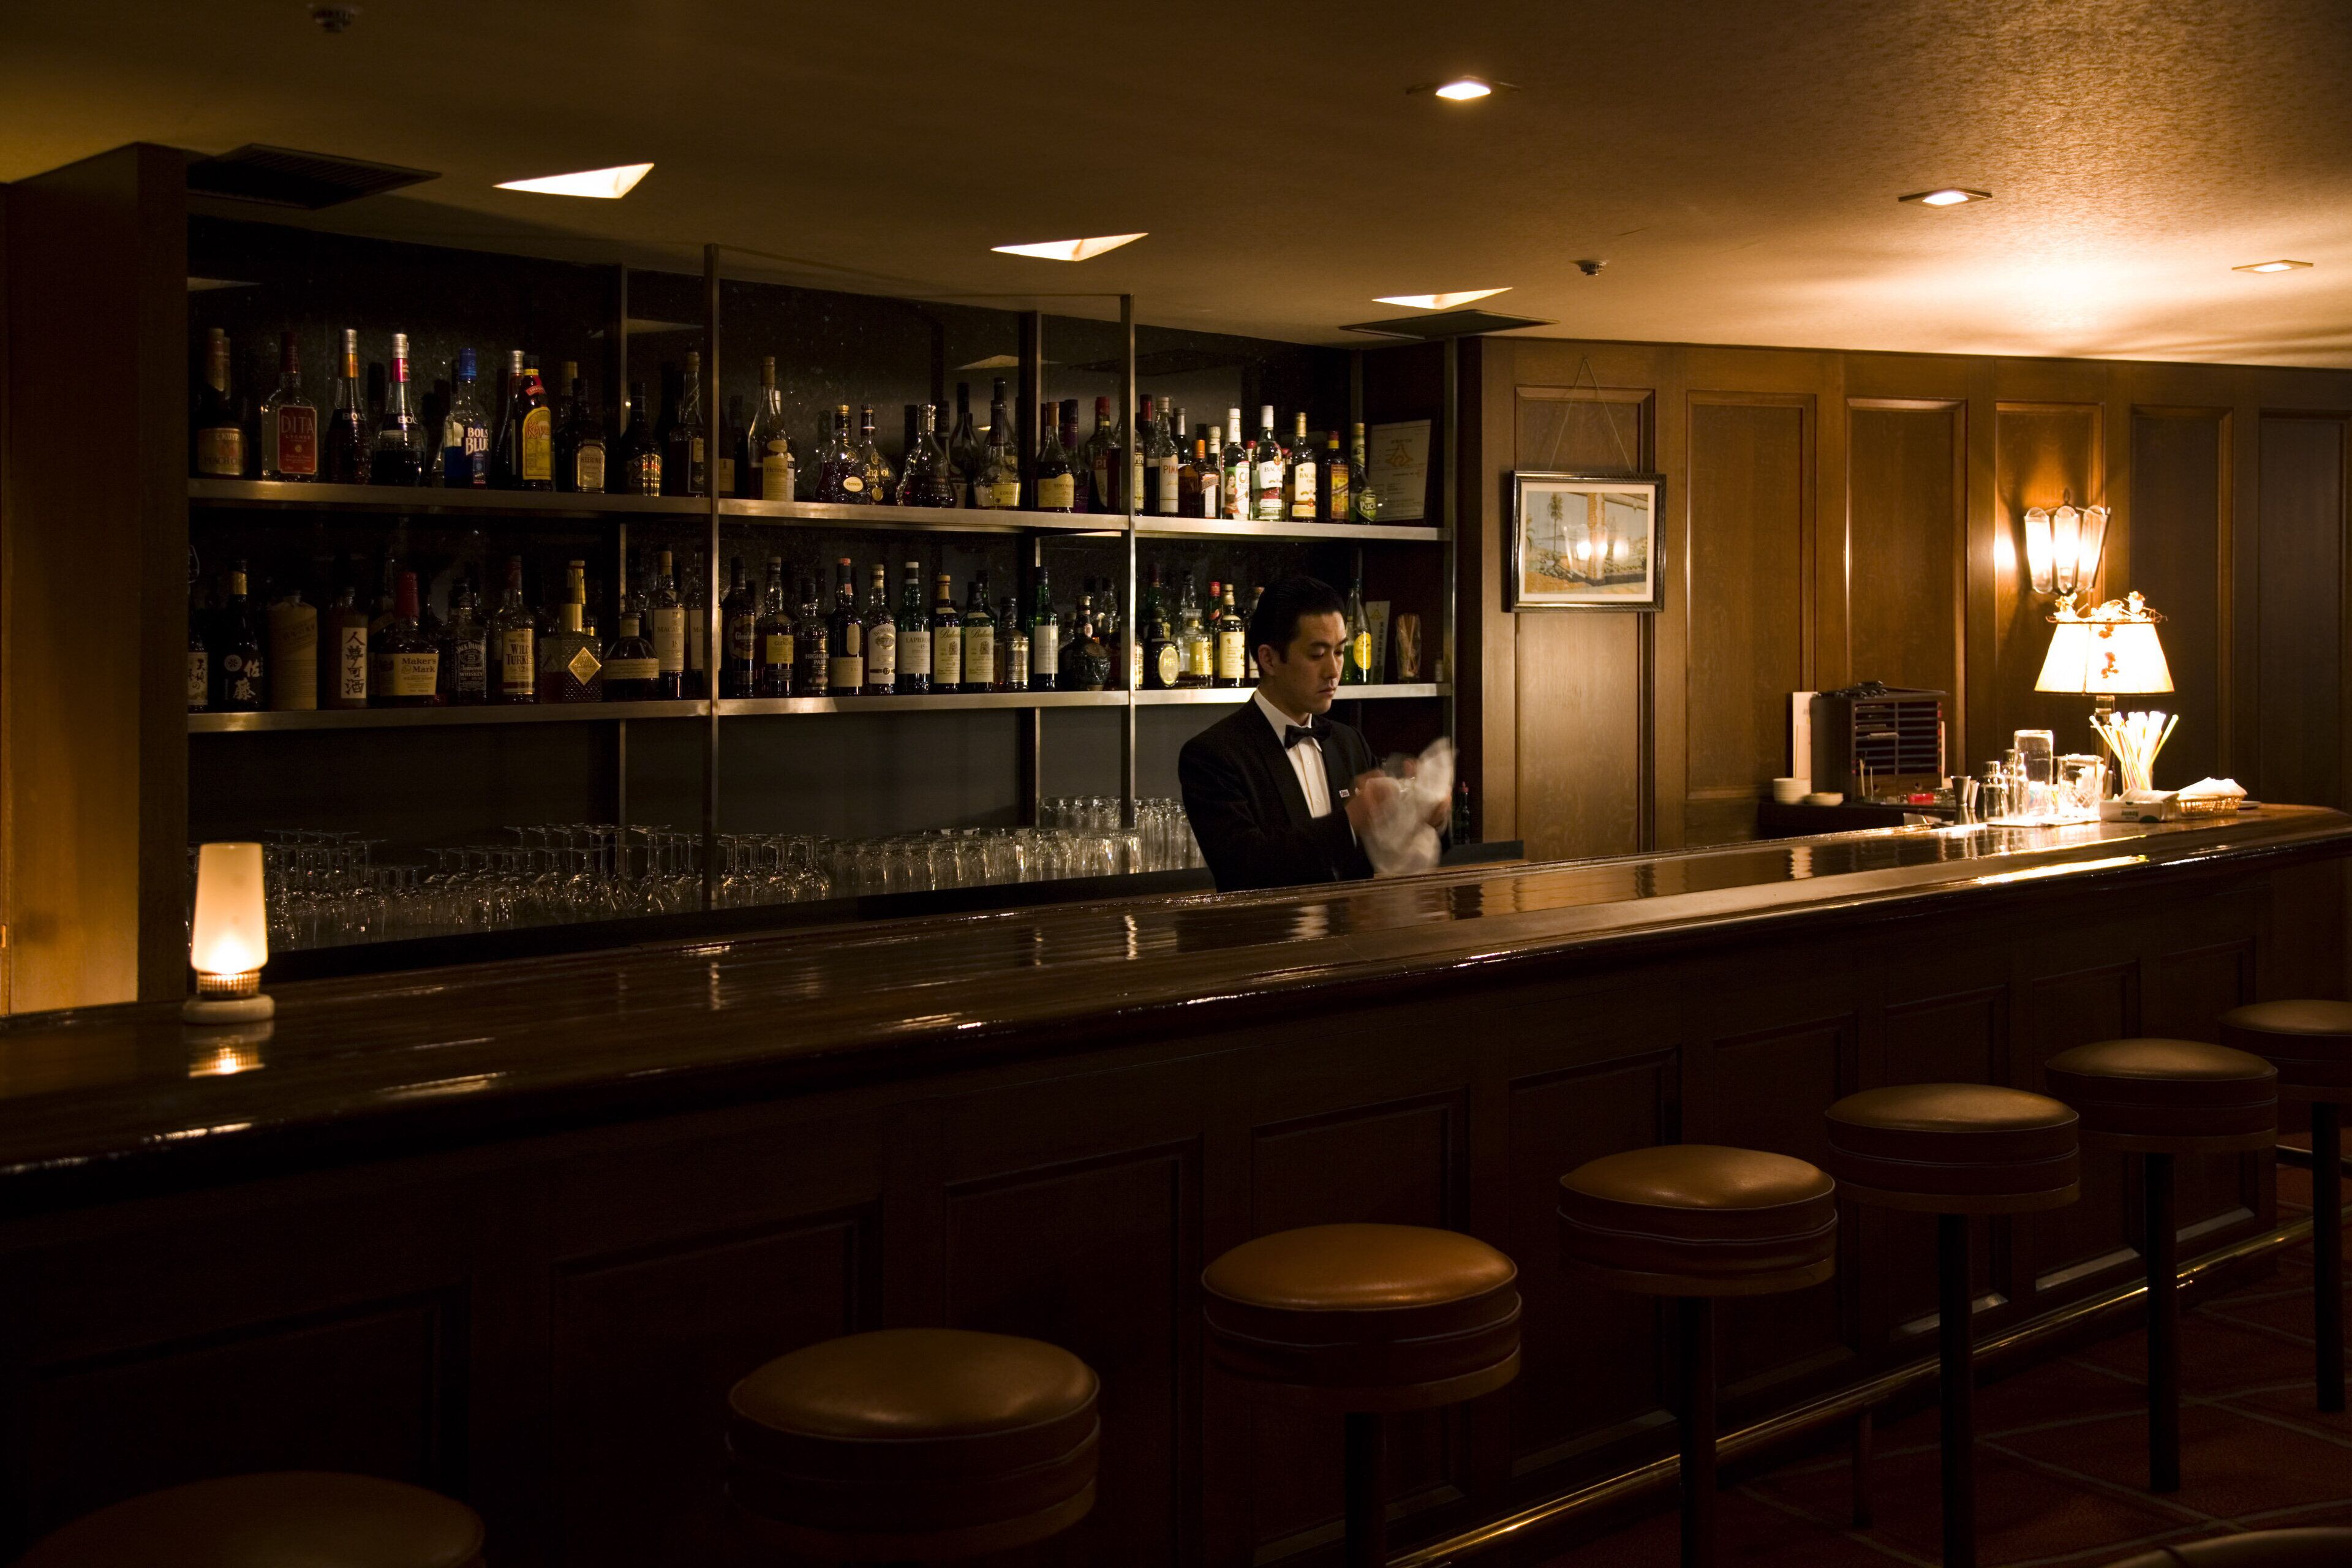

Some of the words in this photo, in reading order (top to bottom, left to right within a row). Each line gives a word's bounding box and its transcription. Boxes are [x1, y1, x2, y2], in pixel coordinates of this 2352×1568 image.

[281, 415, 314, 435] DITA
[467, 427, 489, 437] BOLS
[232, 658, 260, 701] 佐藤
